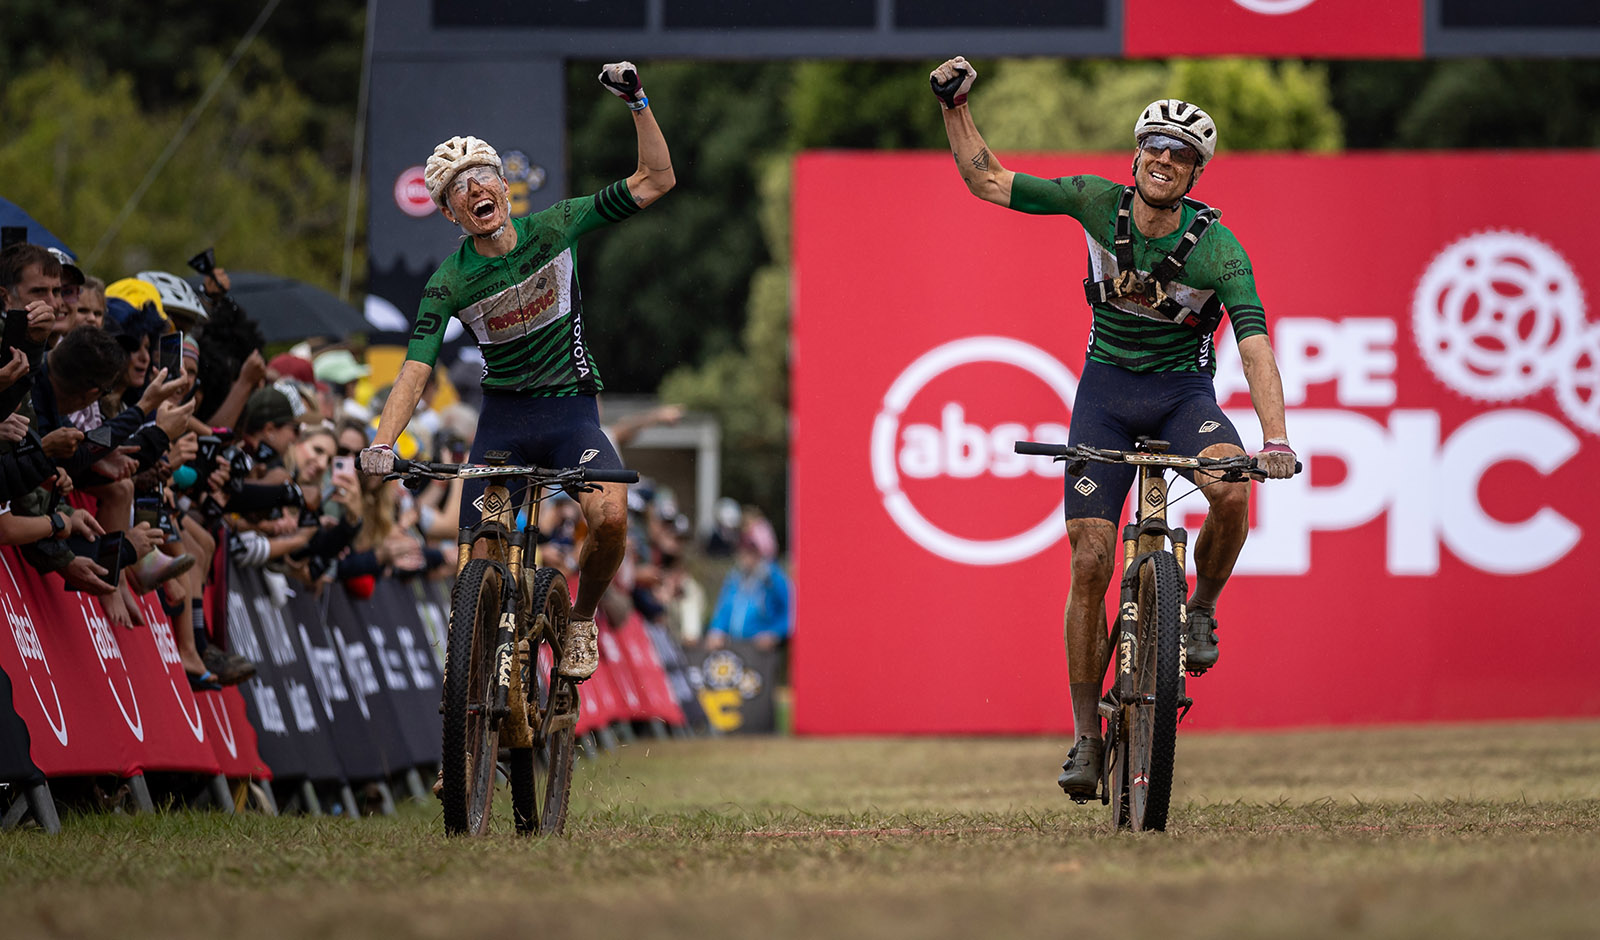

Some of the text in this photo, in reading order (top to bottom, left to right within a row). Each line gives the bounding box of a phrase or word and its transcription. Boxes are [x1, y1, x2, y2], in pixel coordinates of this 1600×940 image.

[469, 280, 507, 301] TOYOTA
[573, 313, 590, 378] TOYOTA
[499, 651, 513, 687] FOX
[1120, 640, 1132, 674] FOX
